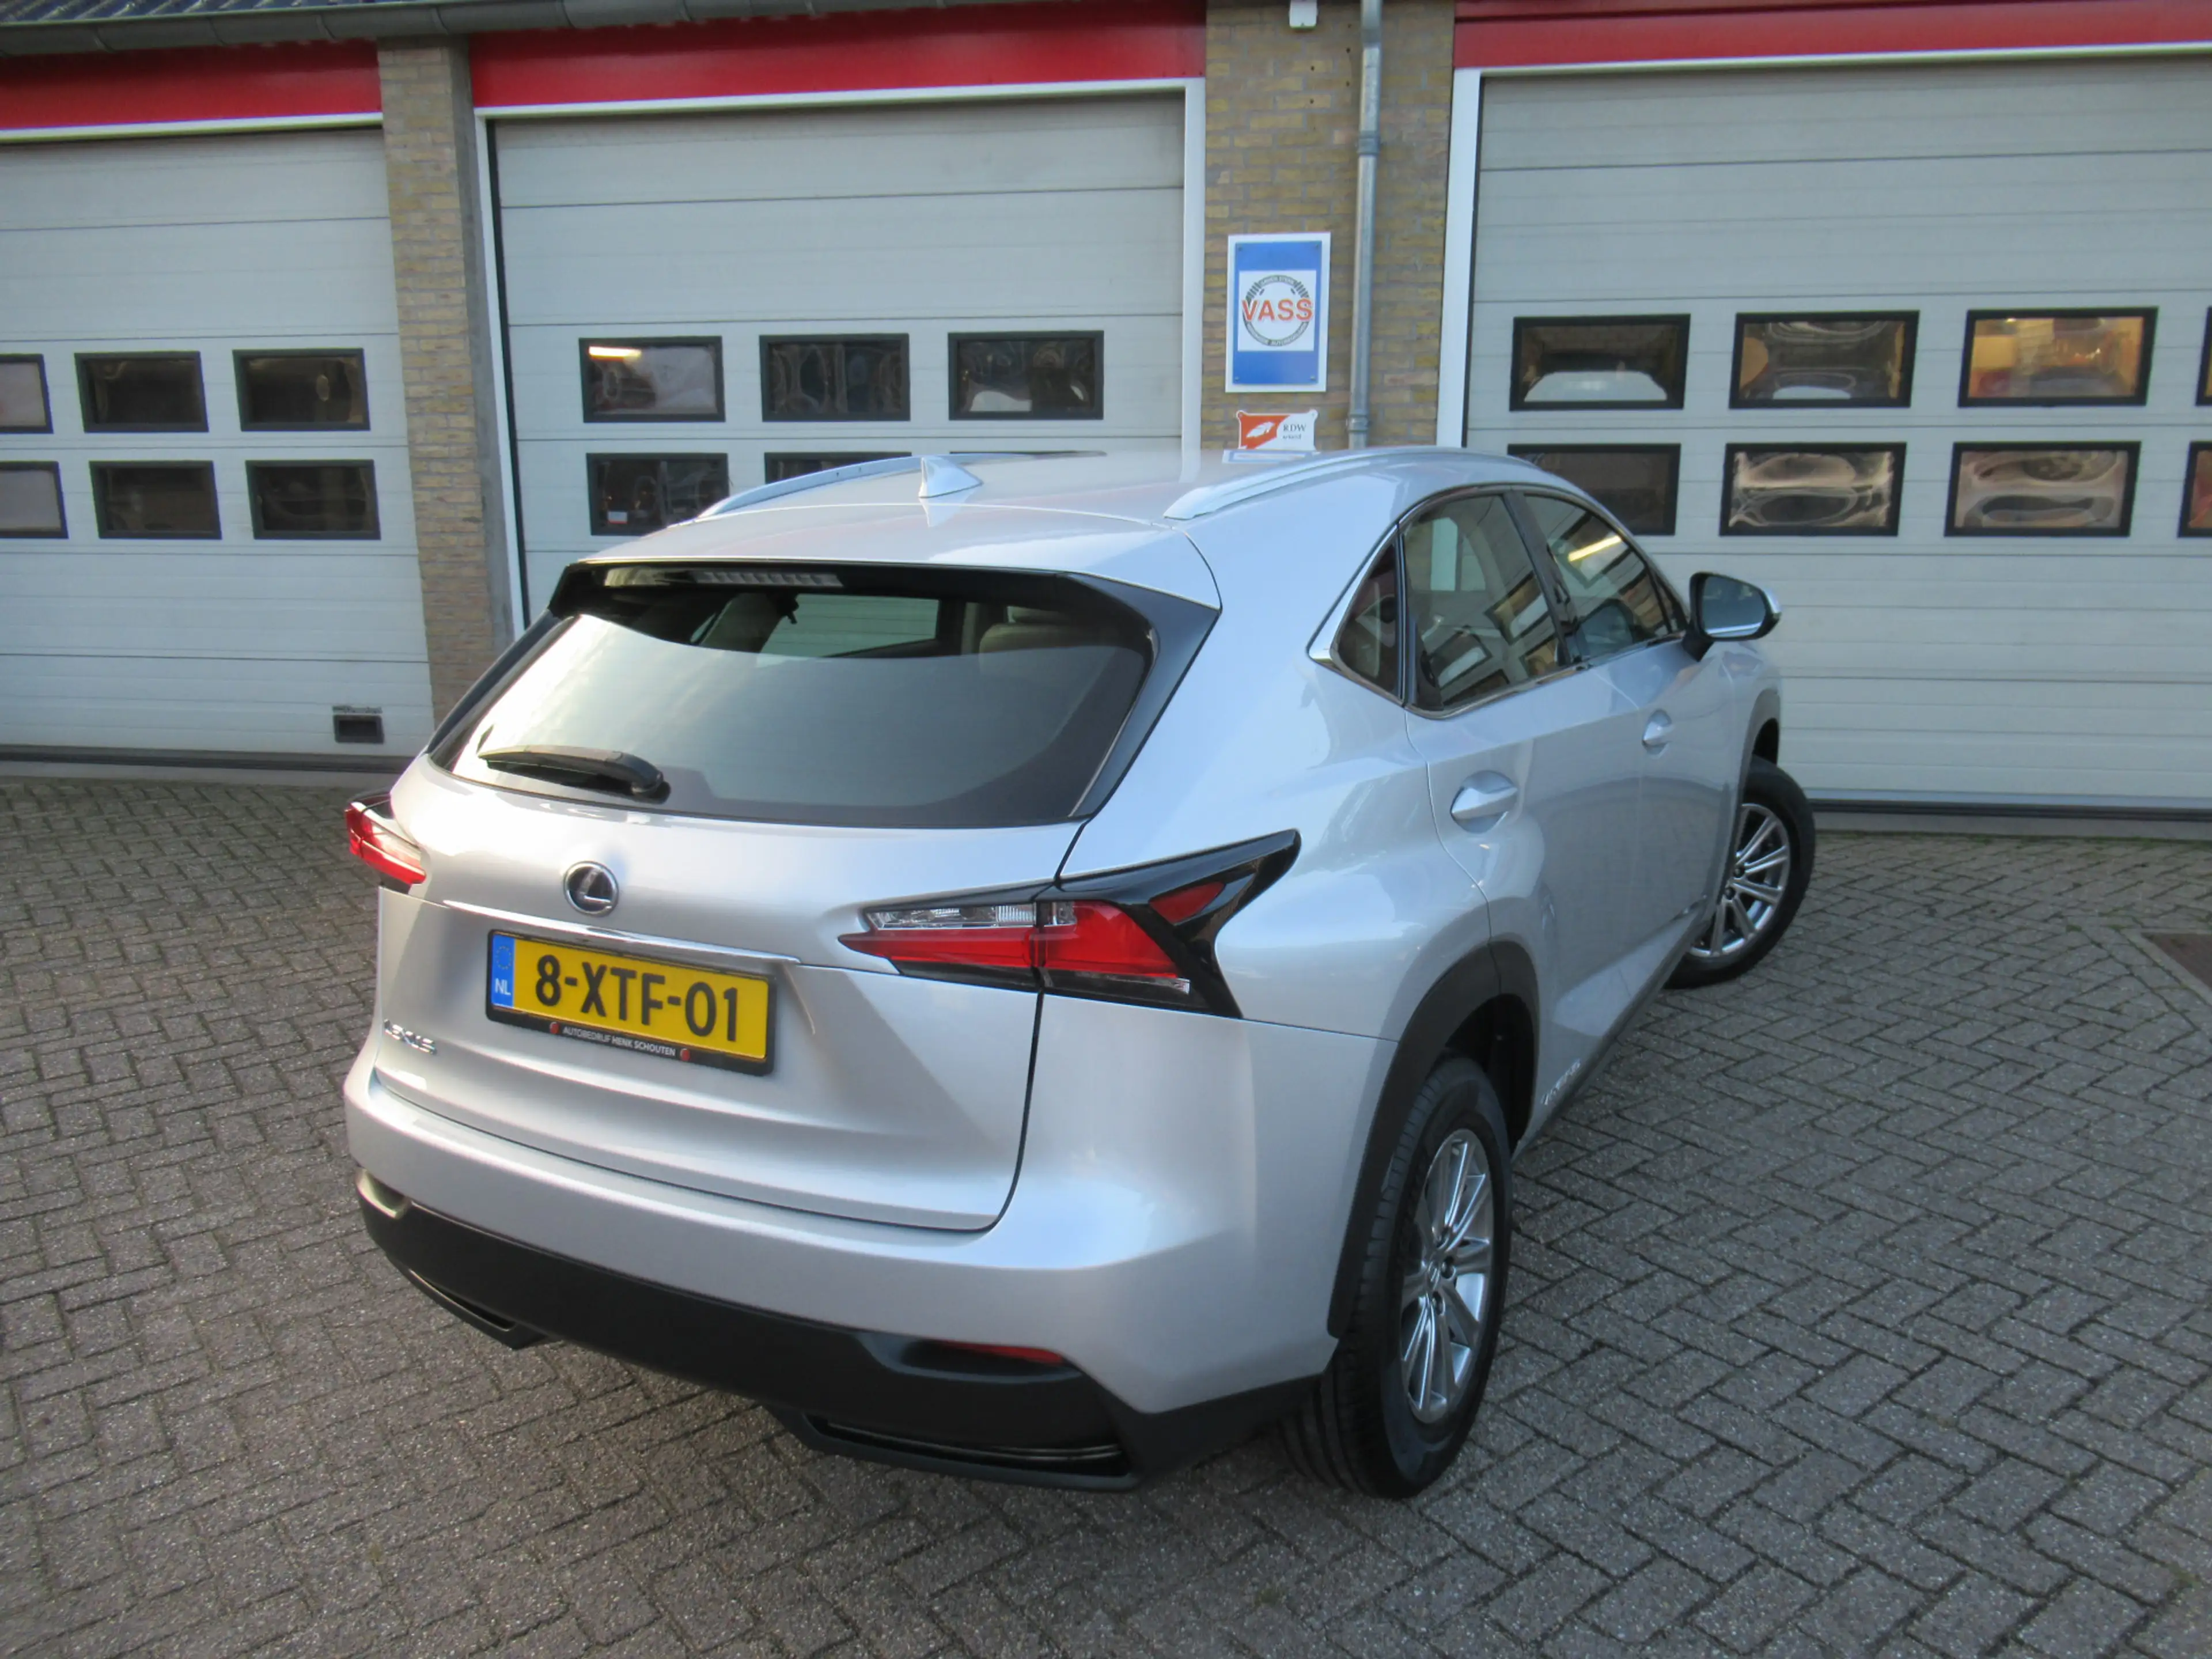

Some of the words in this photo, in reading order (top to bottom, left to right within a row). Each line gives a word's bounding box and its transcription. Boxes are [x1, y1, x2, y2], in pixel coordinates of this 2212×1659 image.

[1241, 298, 1313, 321] VASS
[1283, 423, 1306, 432] RDW
[494, 977, 512, 997] NL
[535, 954, 738, 1042] 8-XTF-01
[562, 1026, 612, 1043] AUTOBEDRIJF
[611, 1035, 633, 1049] HENK
[634, 1040, 676, 1056] SCHOUTEN
